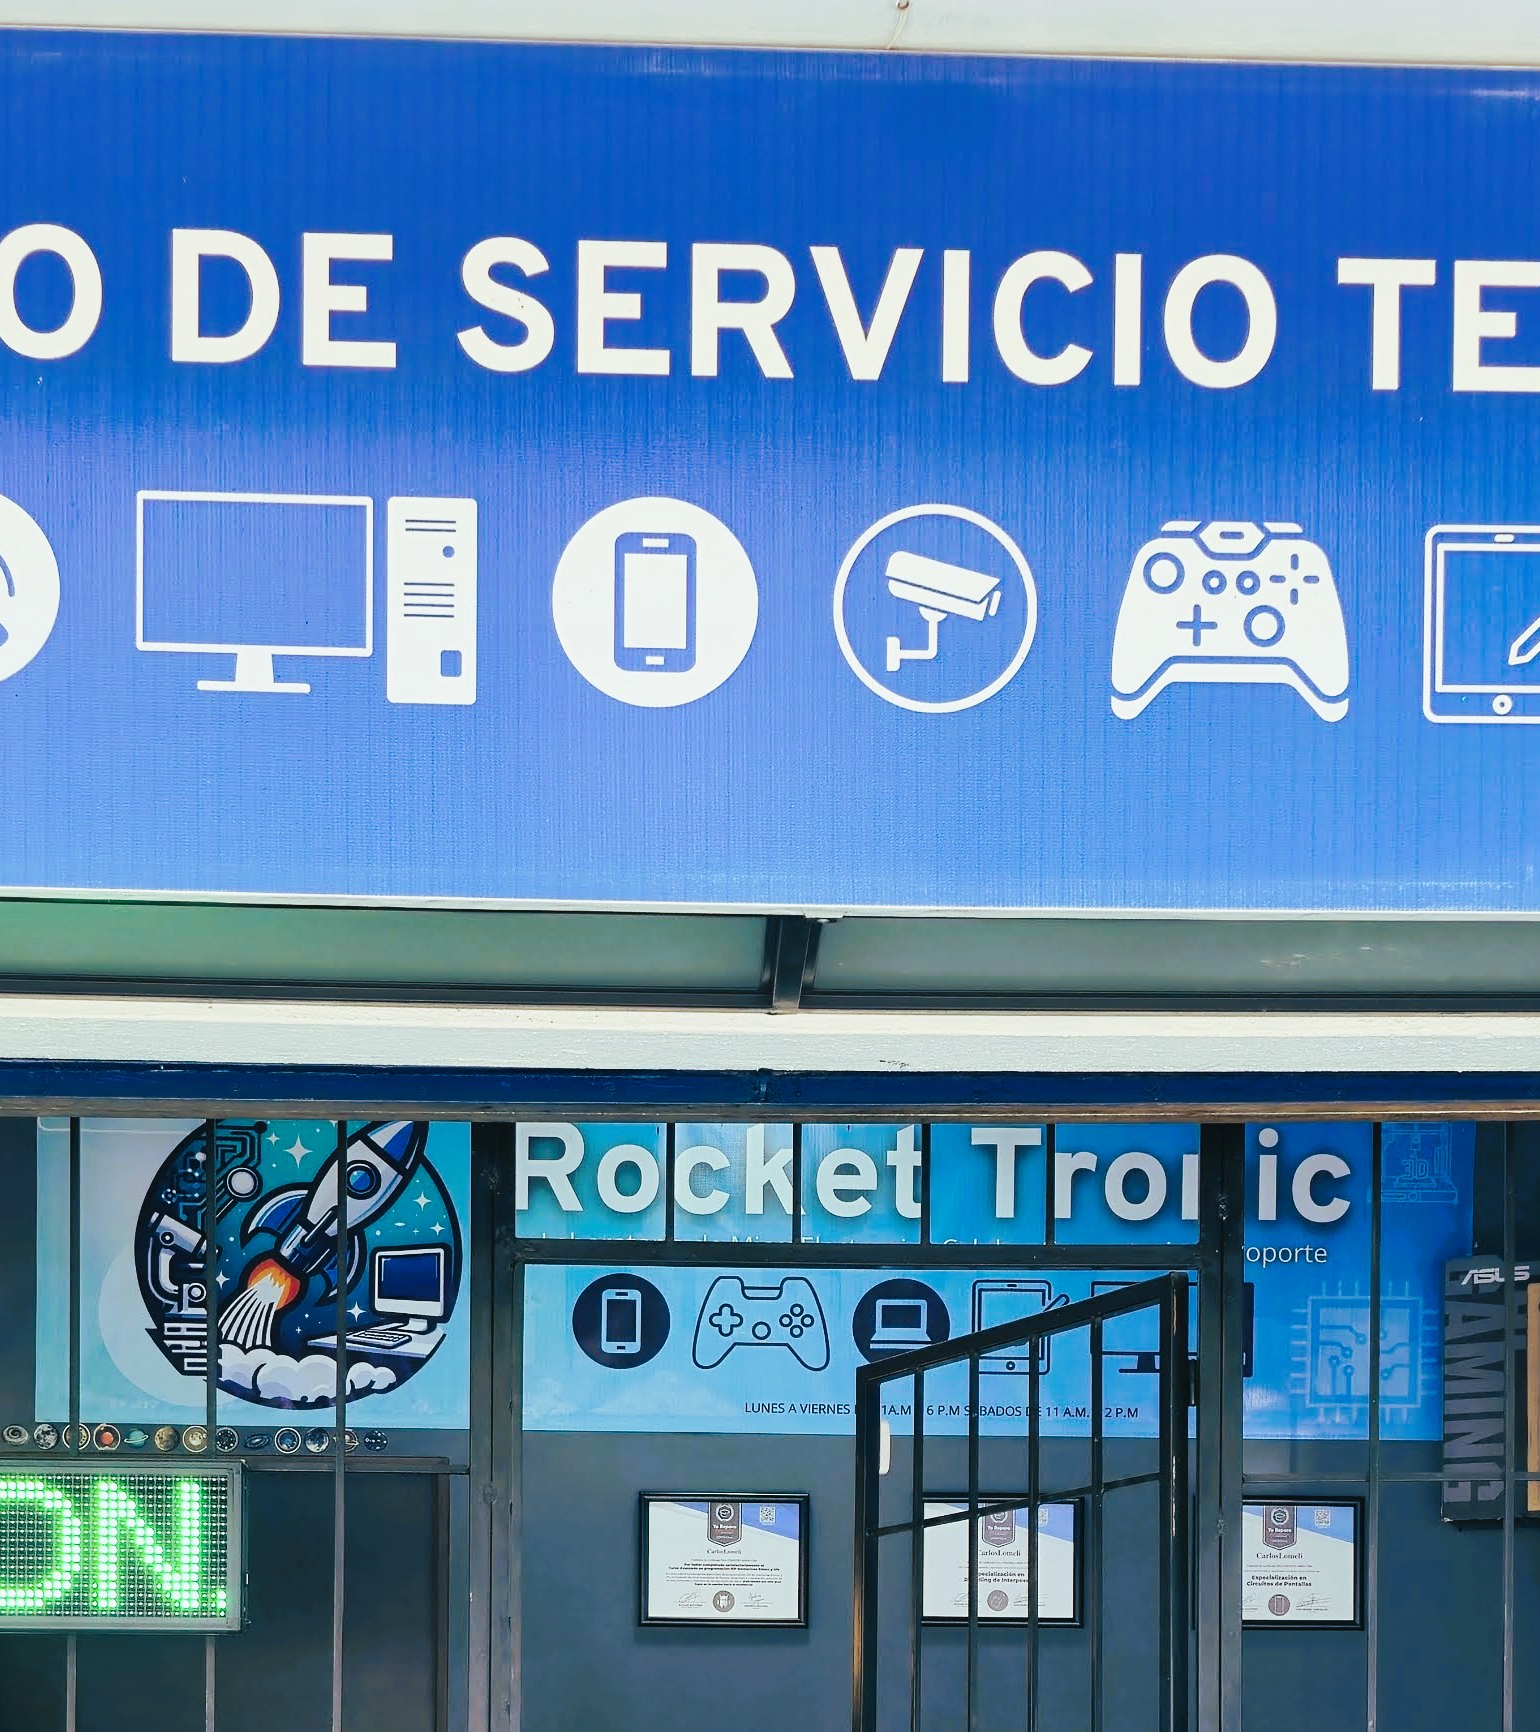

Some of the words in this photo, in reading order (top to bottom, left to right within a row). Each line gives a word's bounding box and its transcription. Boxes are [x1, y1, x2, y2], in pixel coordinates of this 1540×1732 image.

[172, 227, 397, 370] DE
[456, 236, 1277, 390] SERVICIO
[515, 1122, 922, 1219] Rocket
[1243, 1244, 1328, 1268] oporte
[1461, 1265, 1530, 1285] ASUS
[1444, 1255, 1505, 1502] GAMING
[744, 1402, 786, 1414] LUNES
[787, 1403, 798, 1414] A
[799, 1403, 851, 1416] VIERNES
[926, 1405, 934, 1416] 6
[937, 1406, 960, 1417] P.M
[964, 1404, 1021, 1418] SBADOS
[1045, 1406, 1059, 1417] 11
[1114, 1408, 1140, 1419] P.M
[977, 1571, 1017, 1579] pecialización
